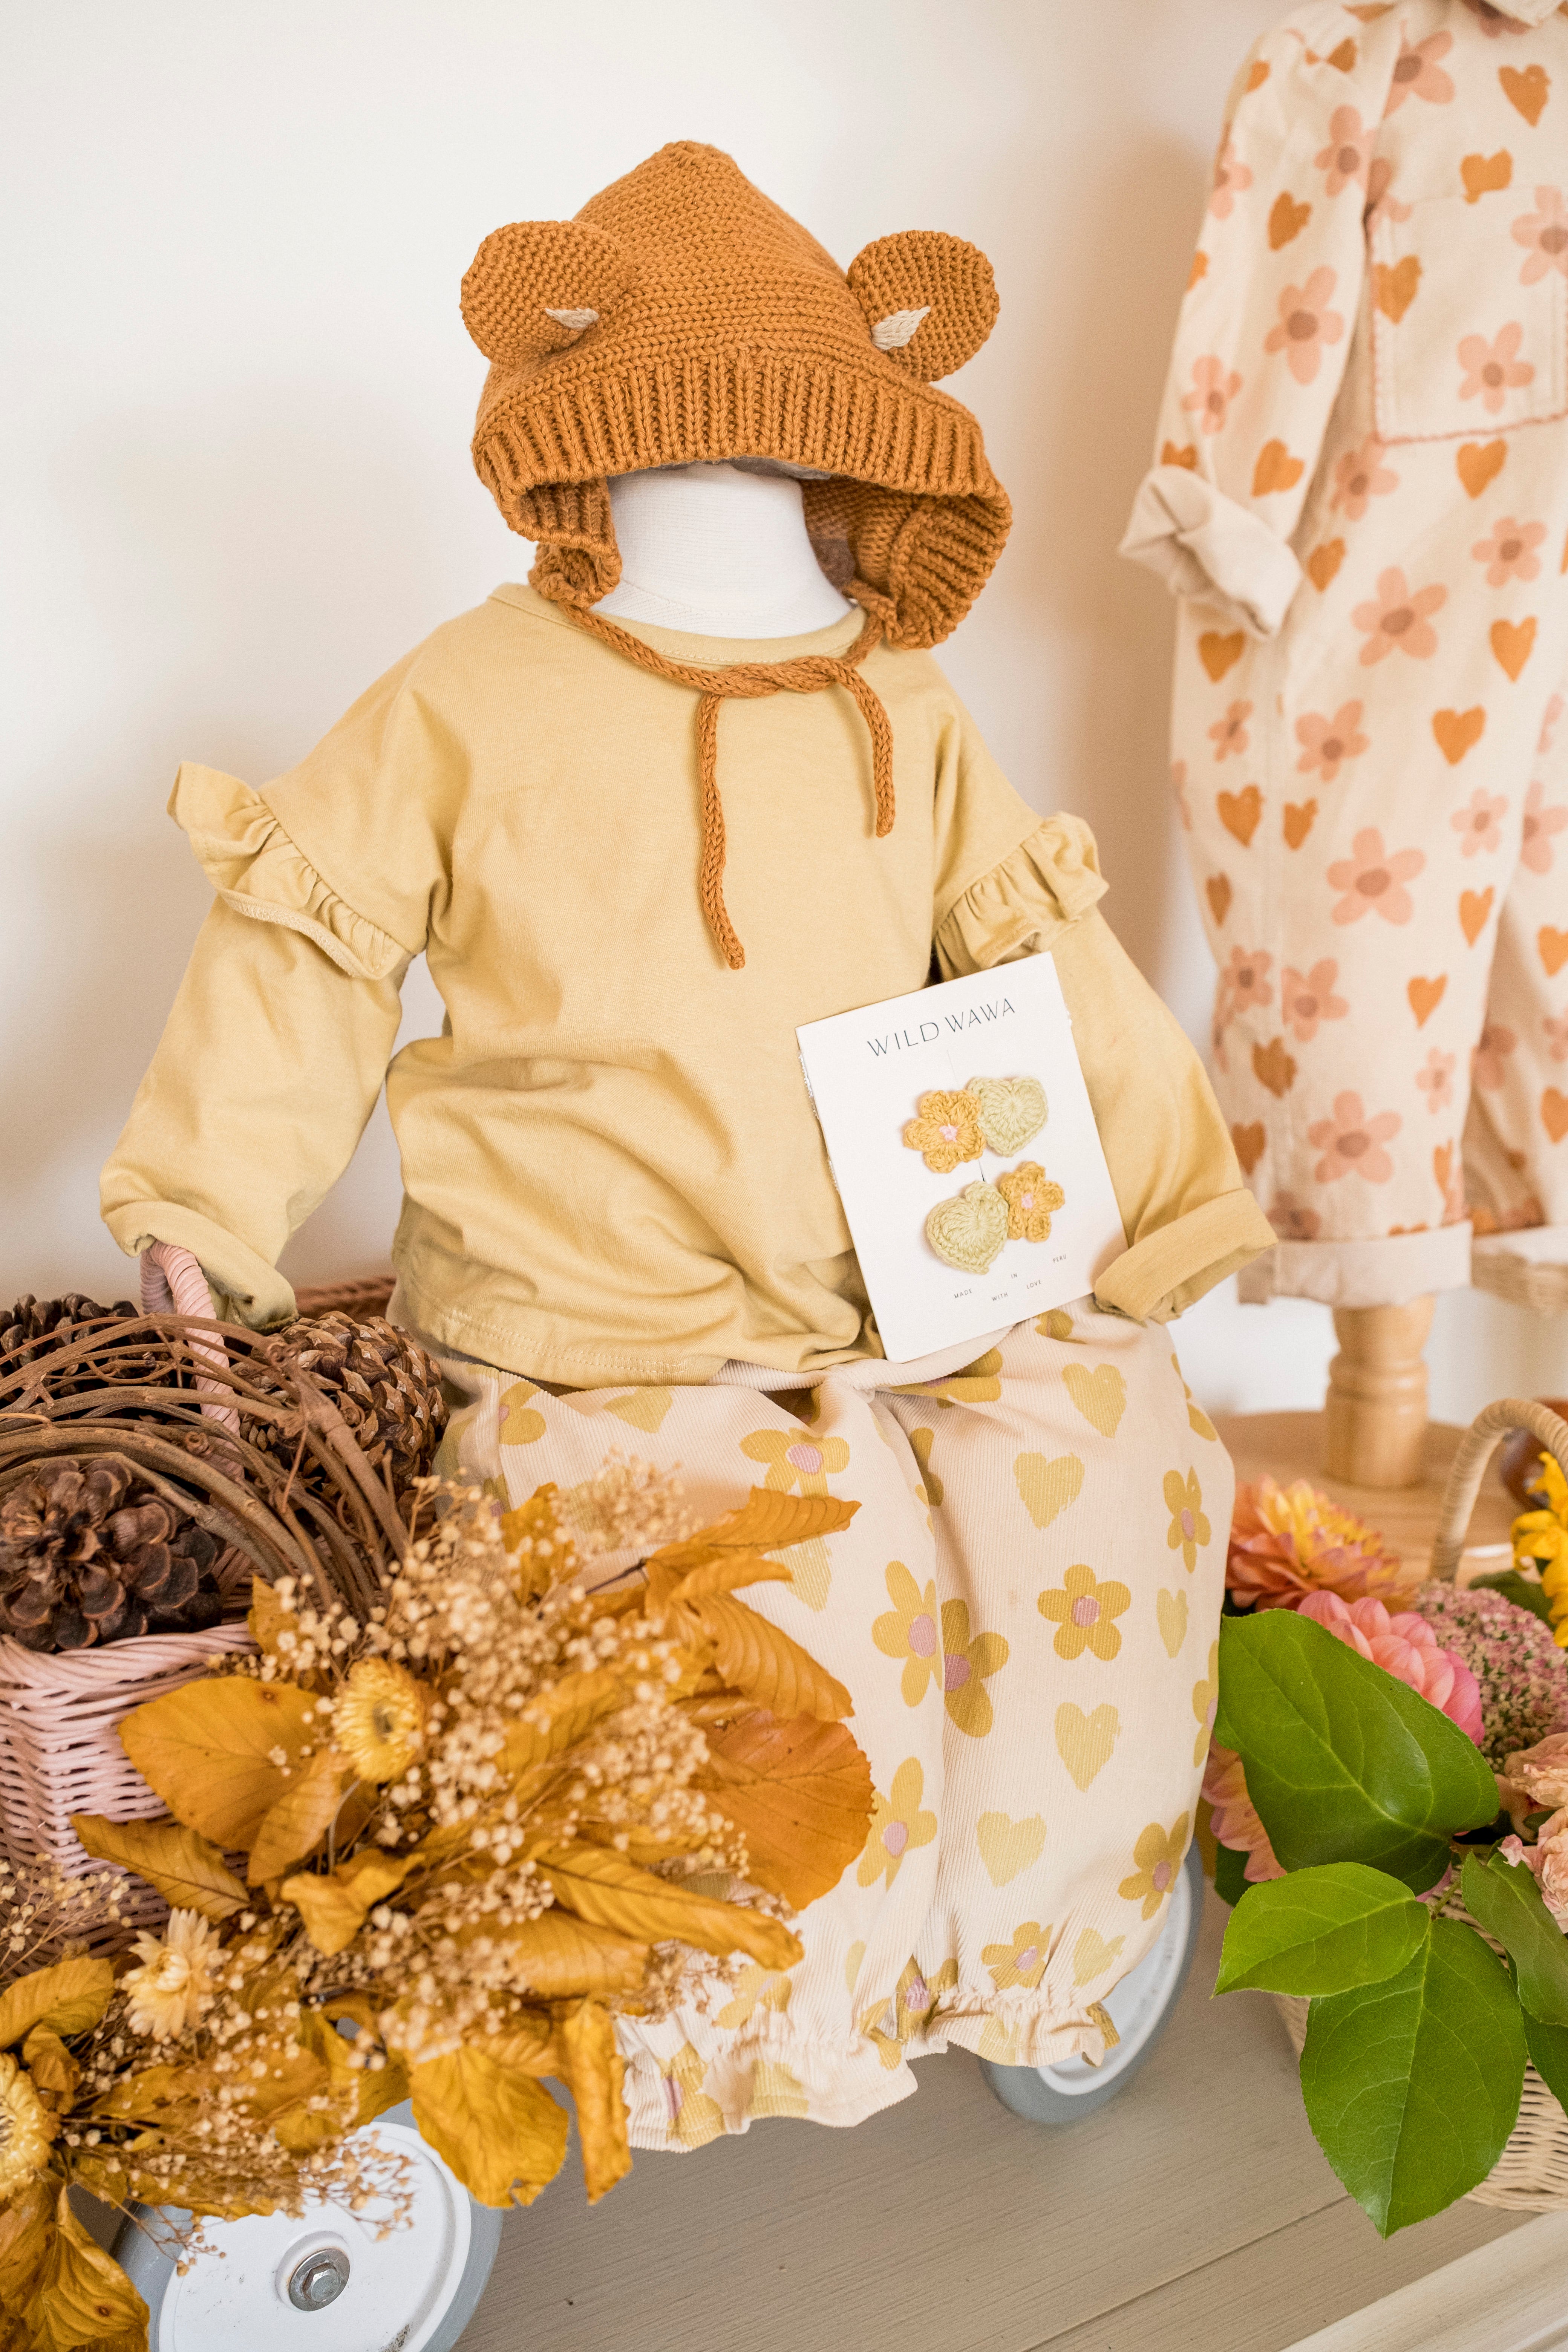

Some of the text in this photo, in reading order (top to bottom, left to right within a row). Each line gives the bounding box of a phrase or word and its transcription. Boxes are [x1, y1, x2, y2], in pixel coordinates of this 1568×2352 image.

[867, 998, 1015, 1057] WILD WAWA
[954, 1288, 972, 1298] MADE
[1053, 1254, 1067, 1263] PERU
[992, 1279, 1042, 1302] WITH LOVE
